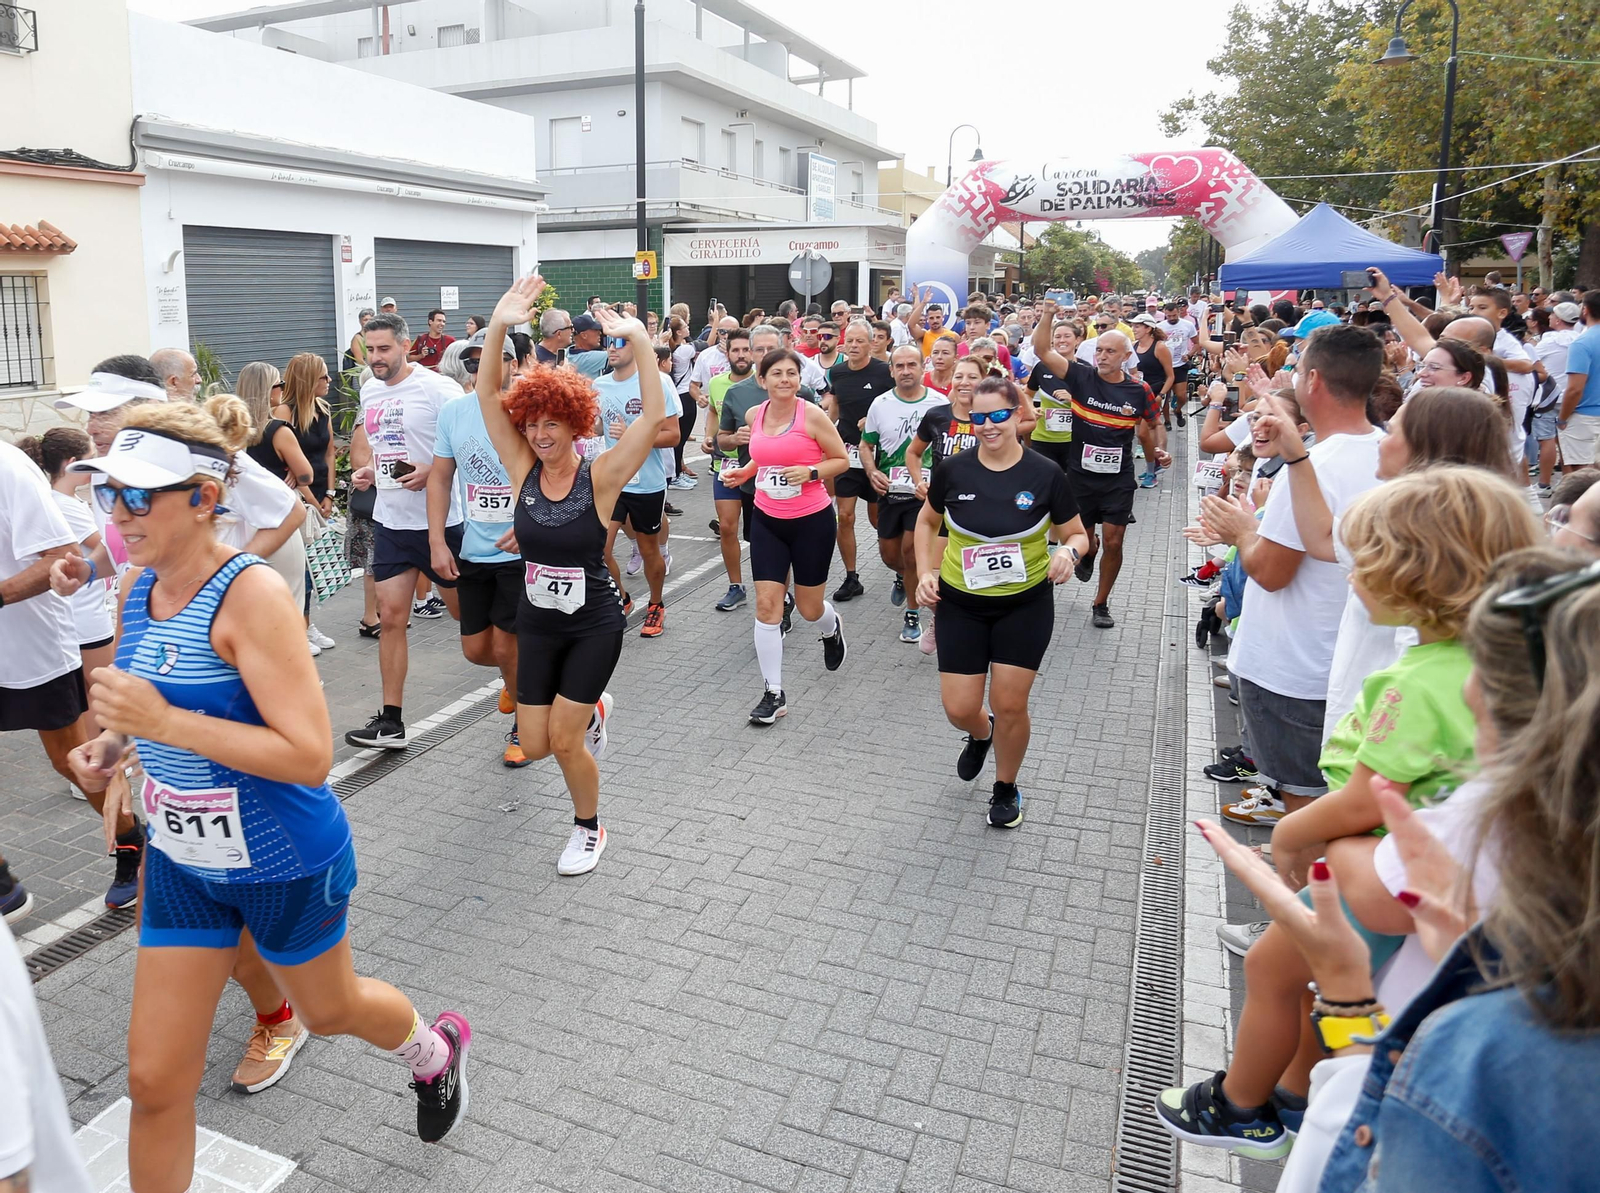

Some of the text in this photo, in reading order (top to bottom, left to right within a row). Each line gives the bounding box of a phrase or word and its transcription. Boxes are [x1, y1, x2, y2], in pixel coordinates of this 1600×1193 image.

[168, 159, 195, 170] Cruzcampo
[1042, 162, 1100, 181] Carrera
[1056, 176, 1159, 197] SOLIDARIA
[1040, 193, 1176, 212] DE PALMONES
[690, 237, 761, 249] CERVECERÍA
[789, 240, 839, 252] Cruzcampo
[690, 248, 762, 260] GIRALDILLO
[481, 451, 501, 475] CARRERA
[1094, 454, 1120, 463] 622
[1204, 468, 1222, 479] 742
[479, 496, 512, 509] 357
[987, 555, 1013, 571] 26
[547, 581, 573, 596] 47
[164, 810, 232, 838] 611
[1242, 1126, 1276, 1138] FILA
